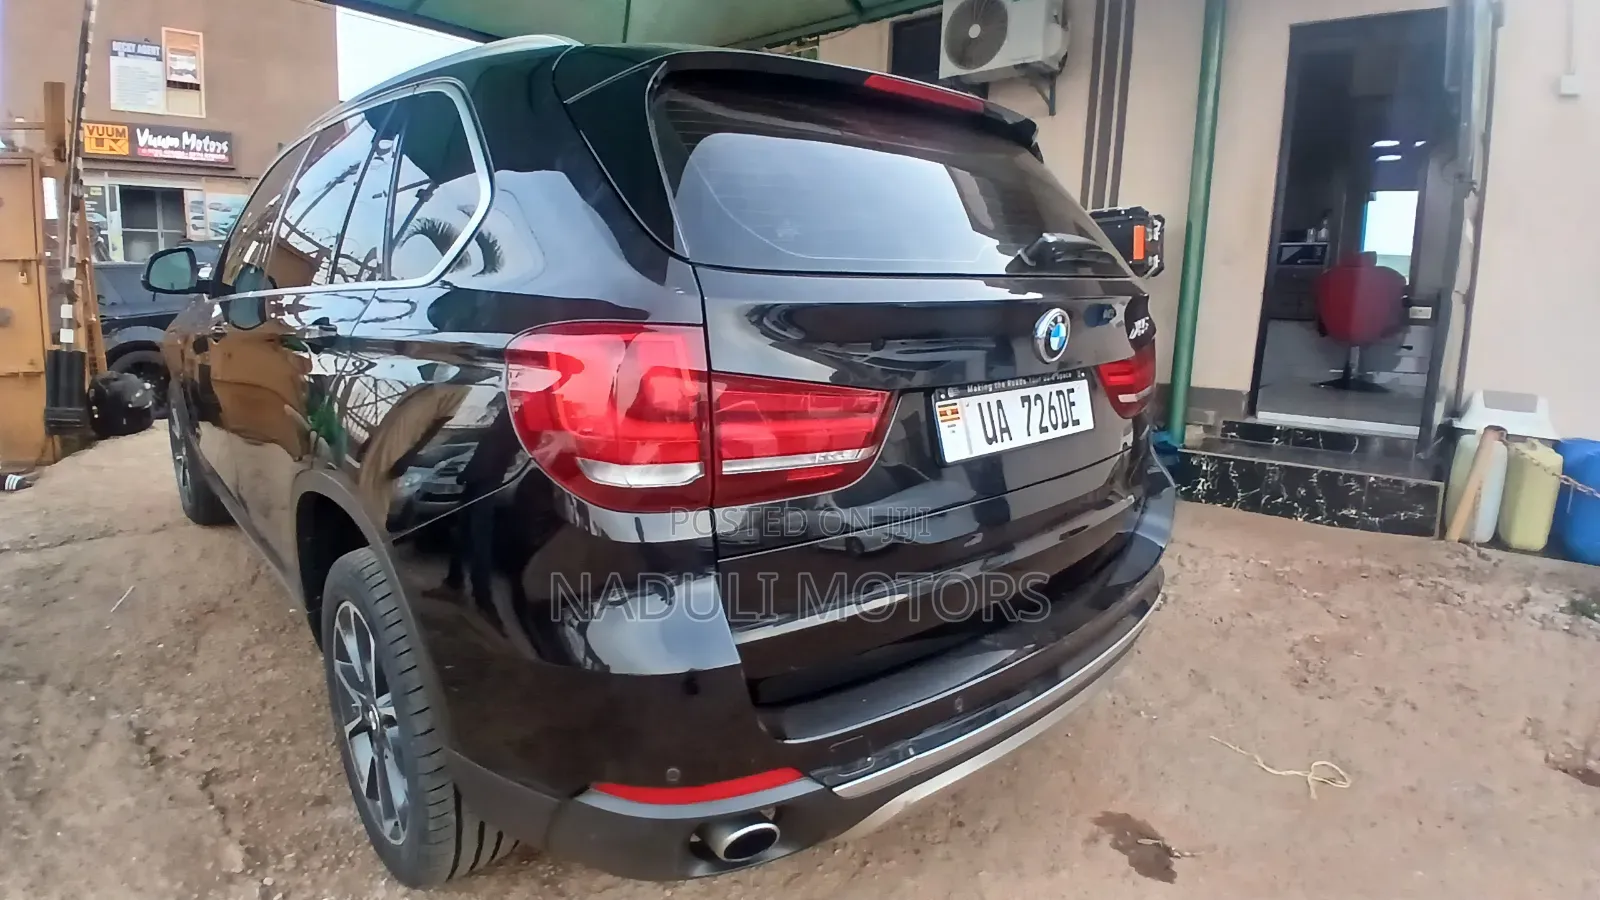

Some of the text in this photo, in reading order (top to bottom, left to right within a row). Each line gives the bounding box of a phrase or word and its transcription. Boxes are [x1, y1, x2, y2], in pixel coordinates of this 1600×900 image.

[87, 125, 126, 138] VUUM
[136, 128, 229, 153] Vuum Motors
[977, 388, 1080, 445] UA 726DE
